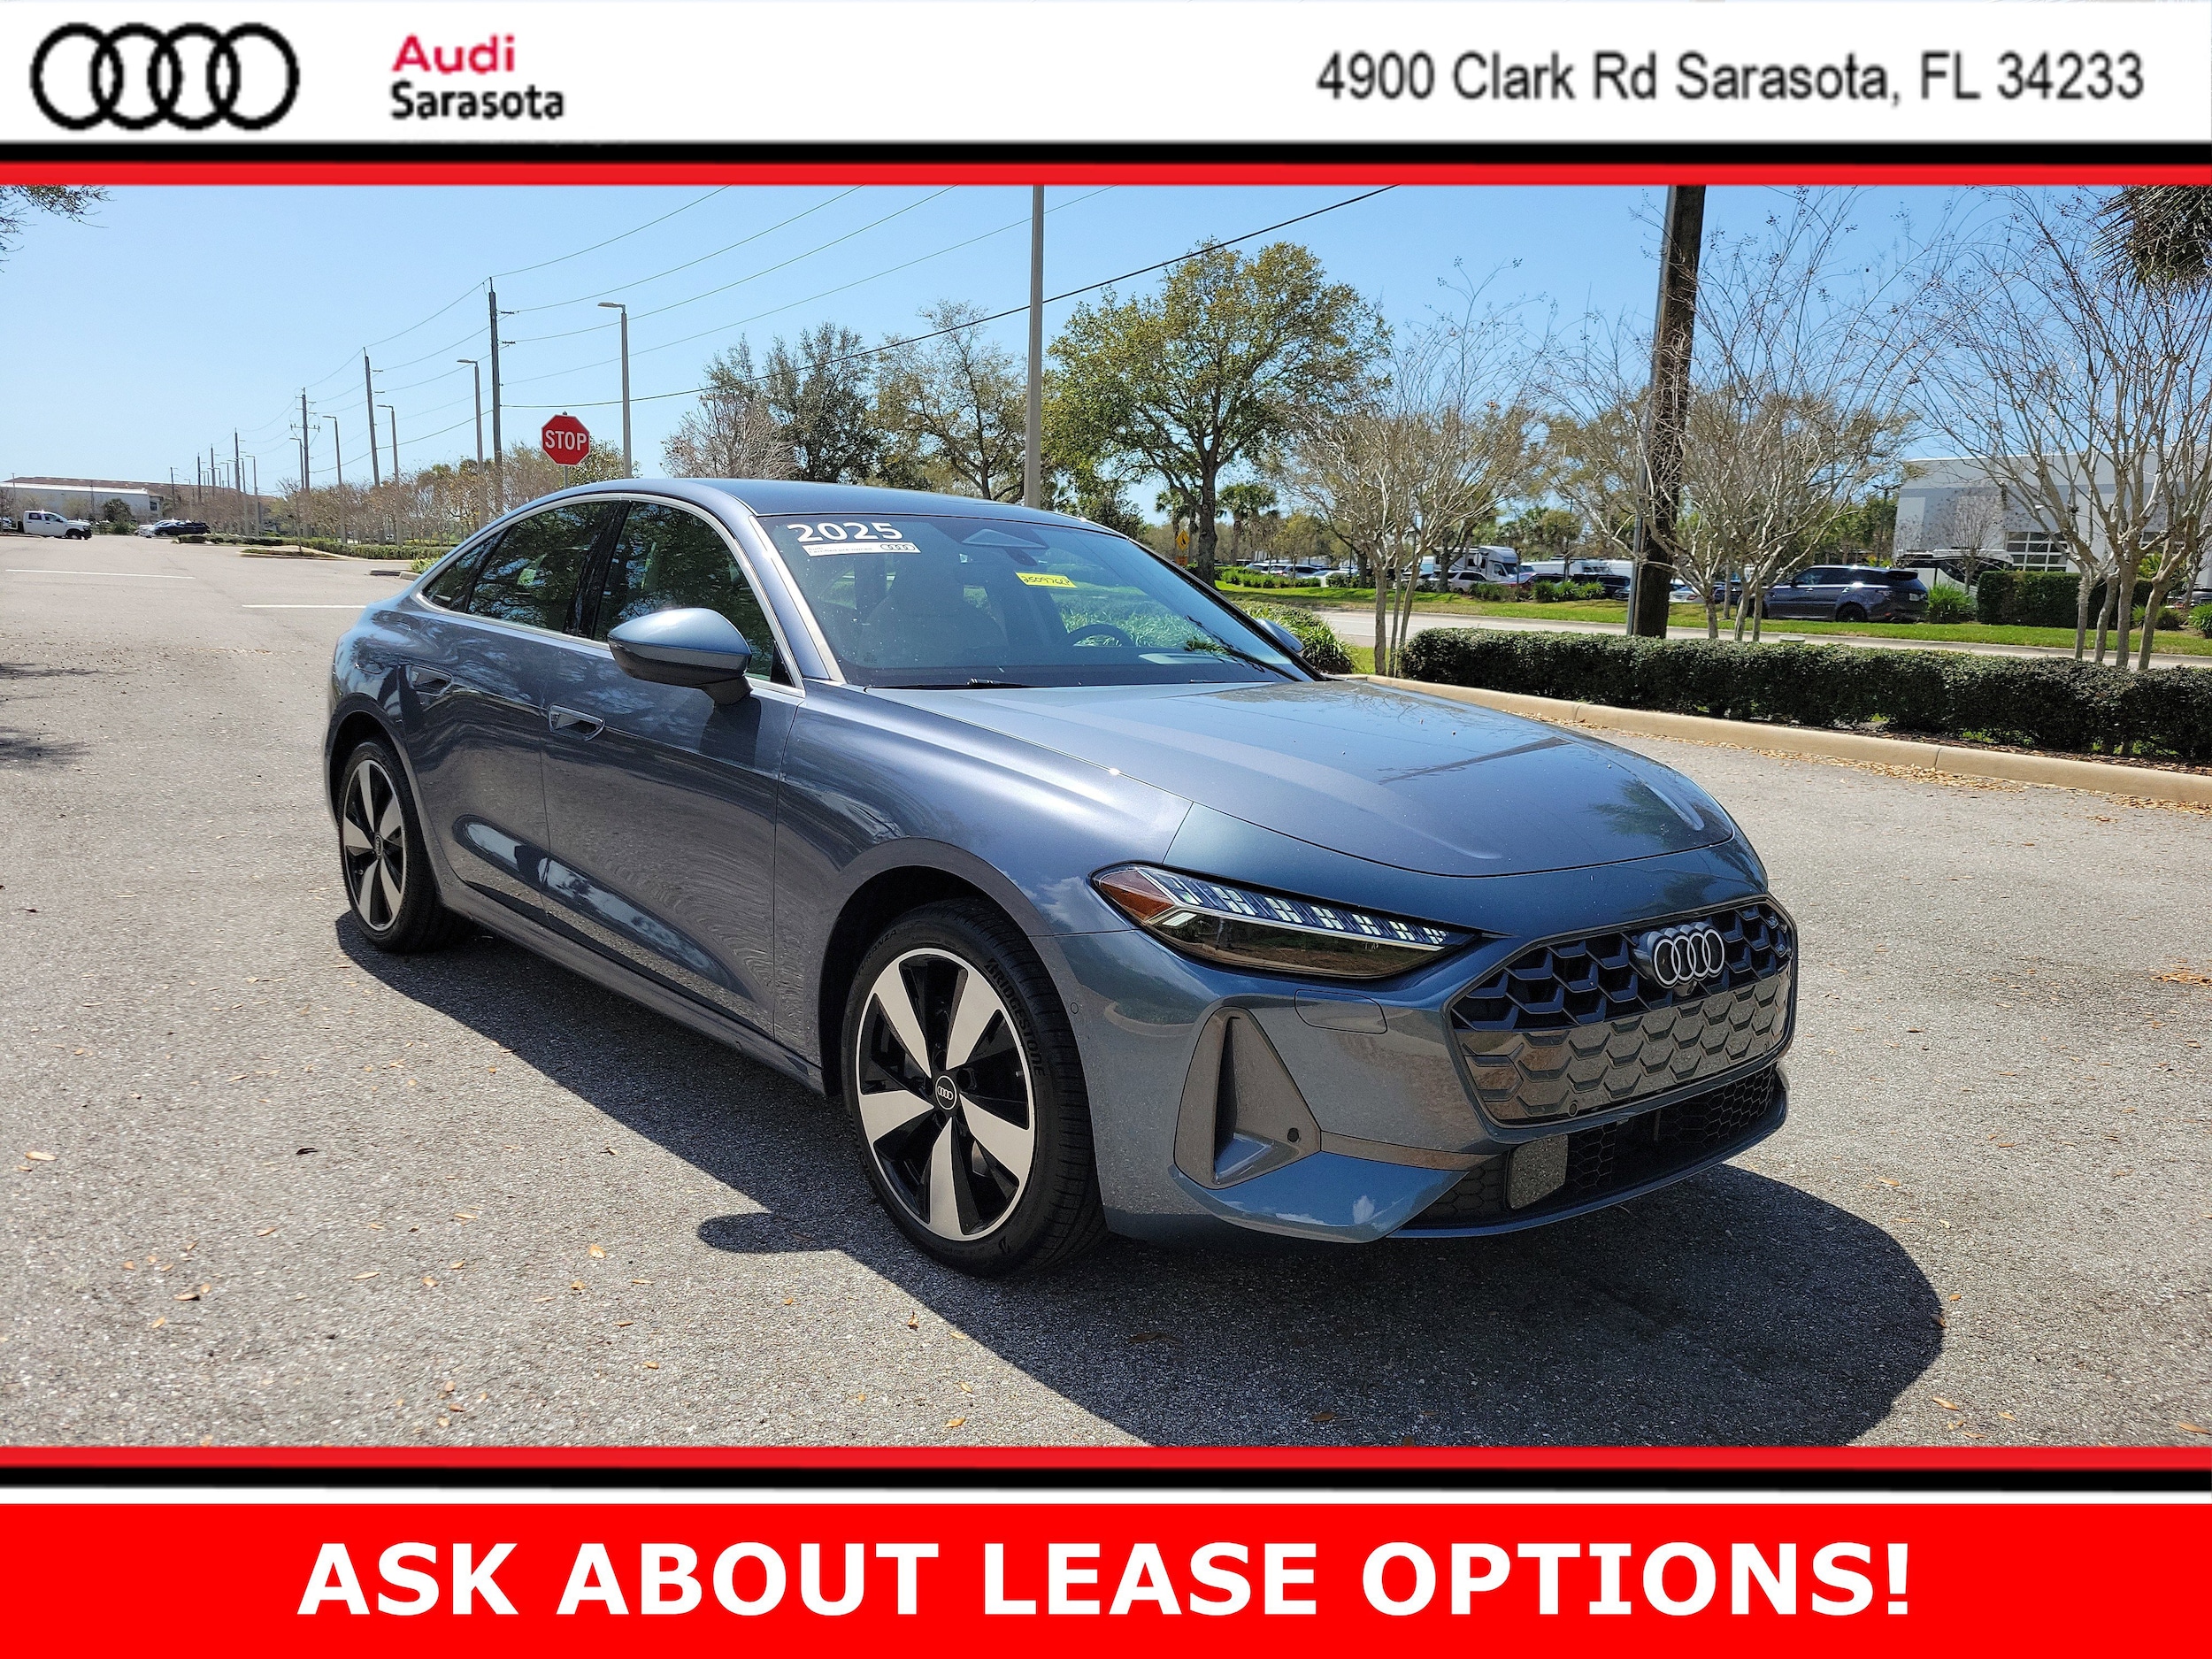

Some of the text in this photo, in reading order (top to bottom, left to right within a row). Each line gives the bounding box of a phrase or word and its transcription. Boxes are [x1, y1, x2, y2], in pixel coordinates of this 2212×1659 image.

[545, 429, 588, 451] STOP
[787, 522, 903, 543] 2025
[984, 957, 1046, 1077] BRIDGESTONE
